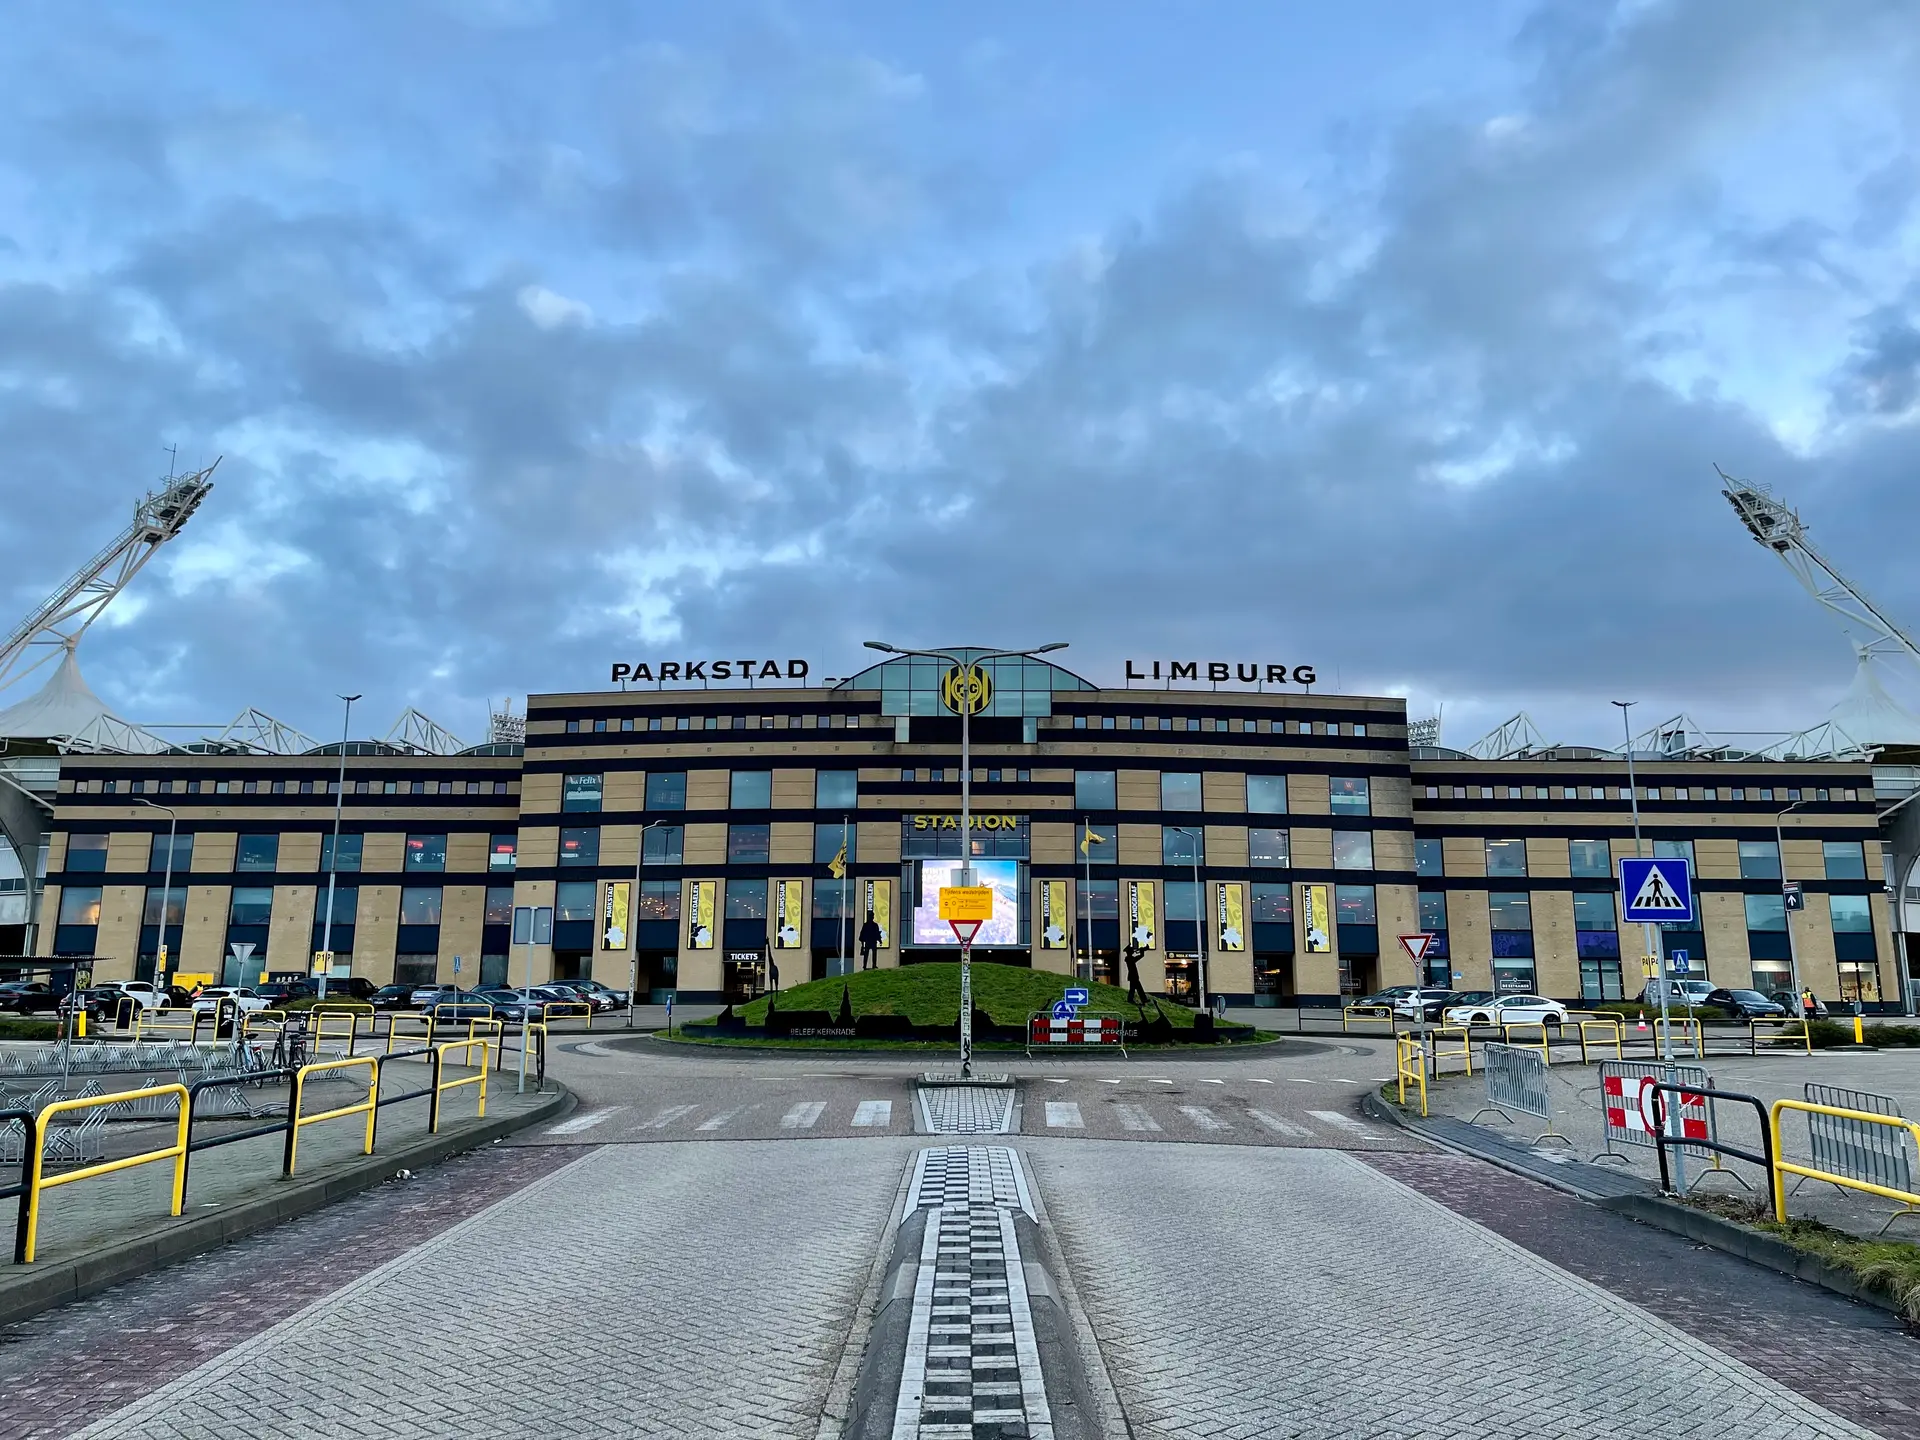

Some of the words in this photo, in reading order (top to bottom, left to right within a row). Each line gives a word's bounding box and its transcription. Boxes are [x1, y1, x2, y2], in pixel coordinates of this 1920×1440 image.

[612, 660, 809, 682] PARKSTAD
[1125, 660, 1316, 684] LIMBURG
[914, 815, 1016, 829] STADION
[606, 886, 614, 917] PARKSTAD
[790, 1028, 815, 1036] BELEEF
[817, 1028, 856, 1036] KERKRADE
